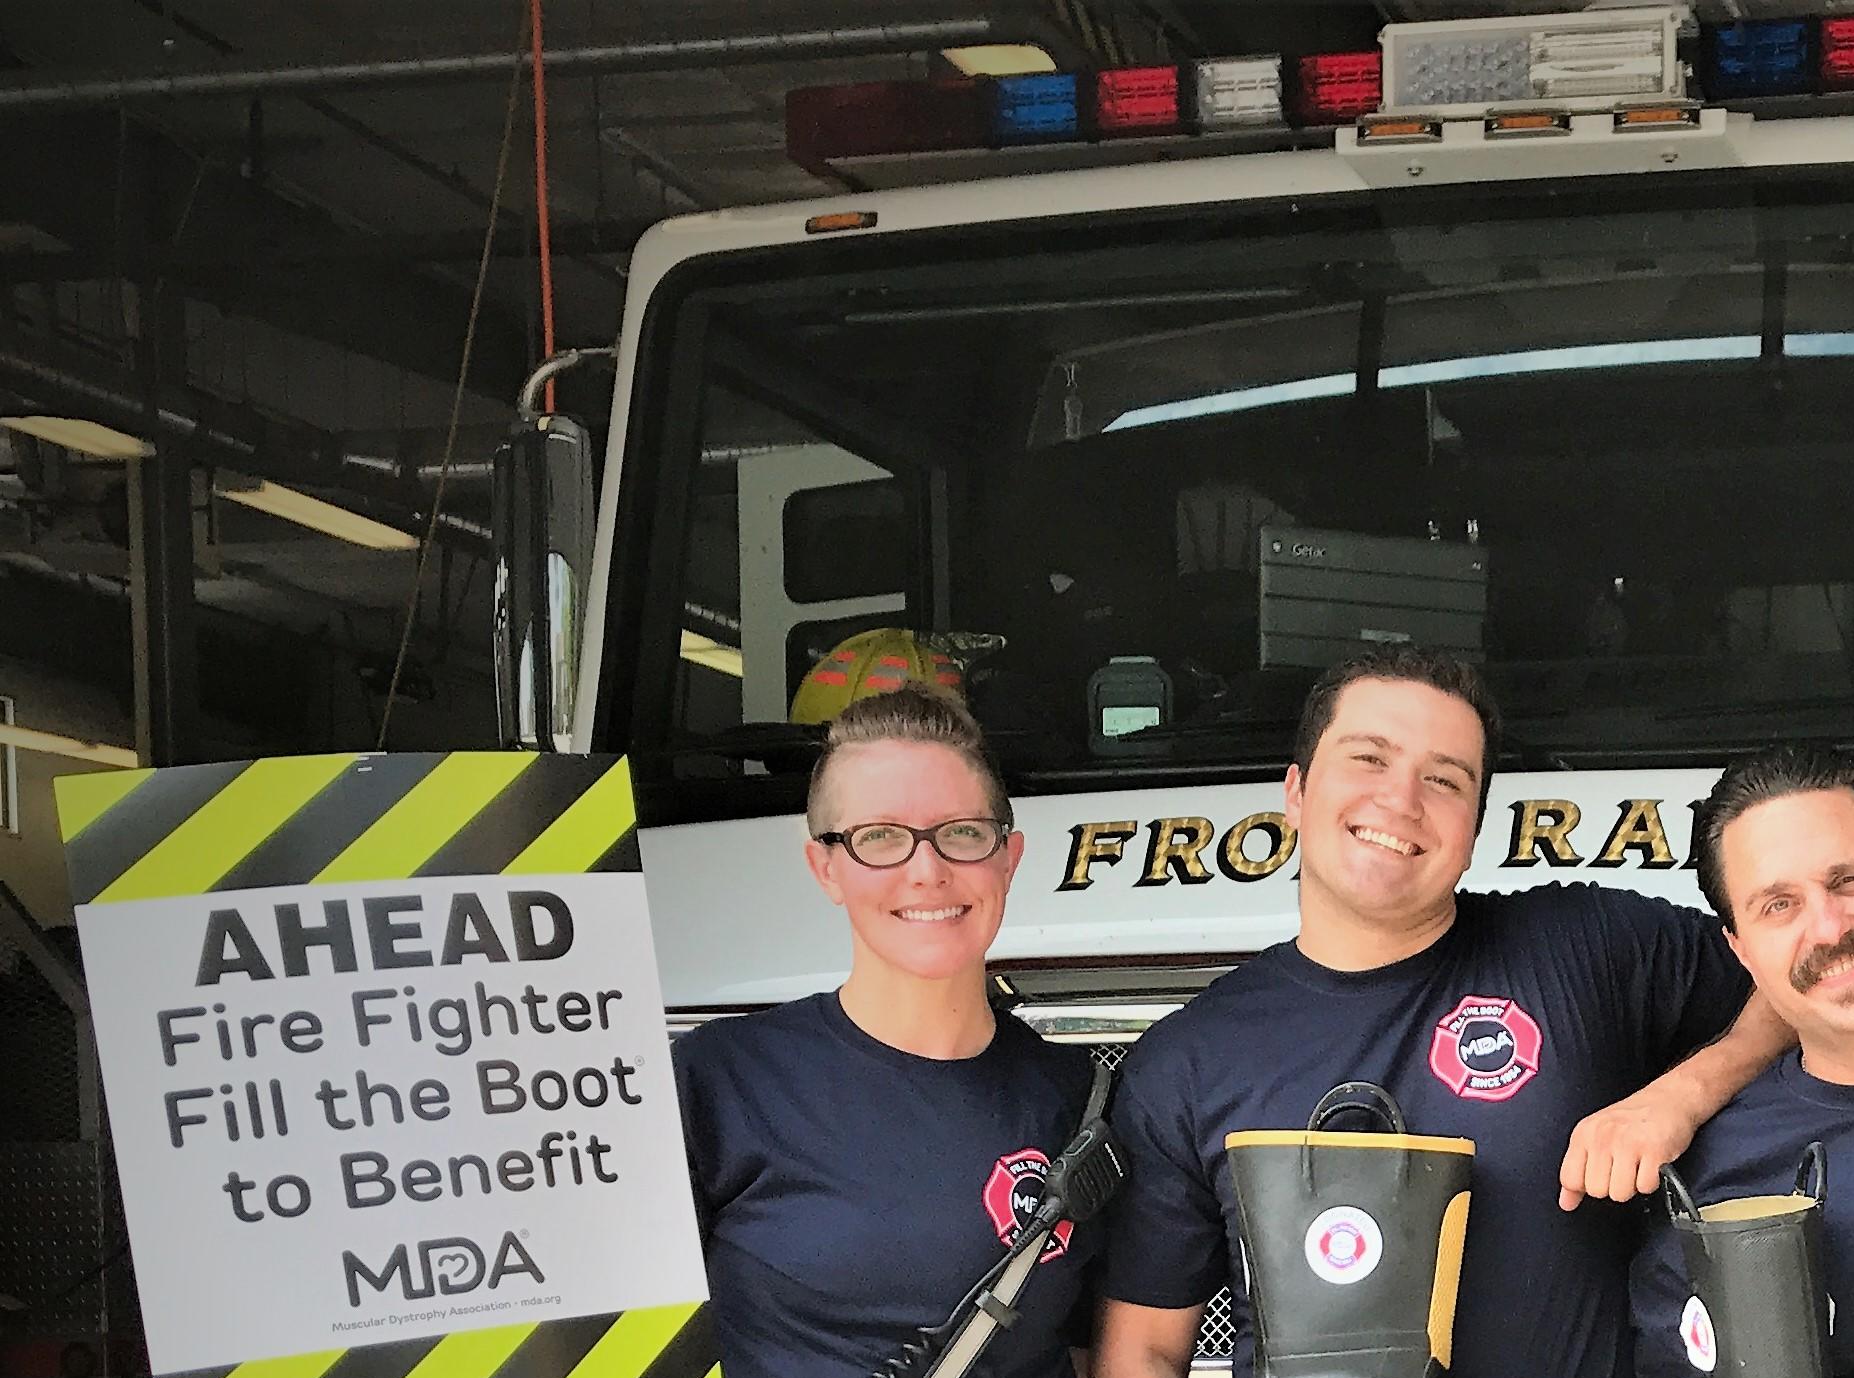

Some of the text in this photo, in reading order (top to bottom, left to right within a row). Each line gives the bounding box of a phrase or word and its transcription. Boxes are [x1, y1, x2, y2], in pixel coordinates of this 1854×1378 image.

[1053, 811, 1300, 892] FRO
[195, 889, 576, 988] AHEAD
[156, 980, 624, 1068] Fire Fighter
[1460, 1030, 1514, 1061] MDA
[163, 1078, 289, 1149] Fill
[315, 1069, 452, 1131] the
[221, 1129, 619, 1224] to Benefit
[332, 1294, 562, 1333] Muscular Dystrophy Association mda.org
